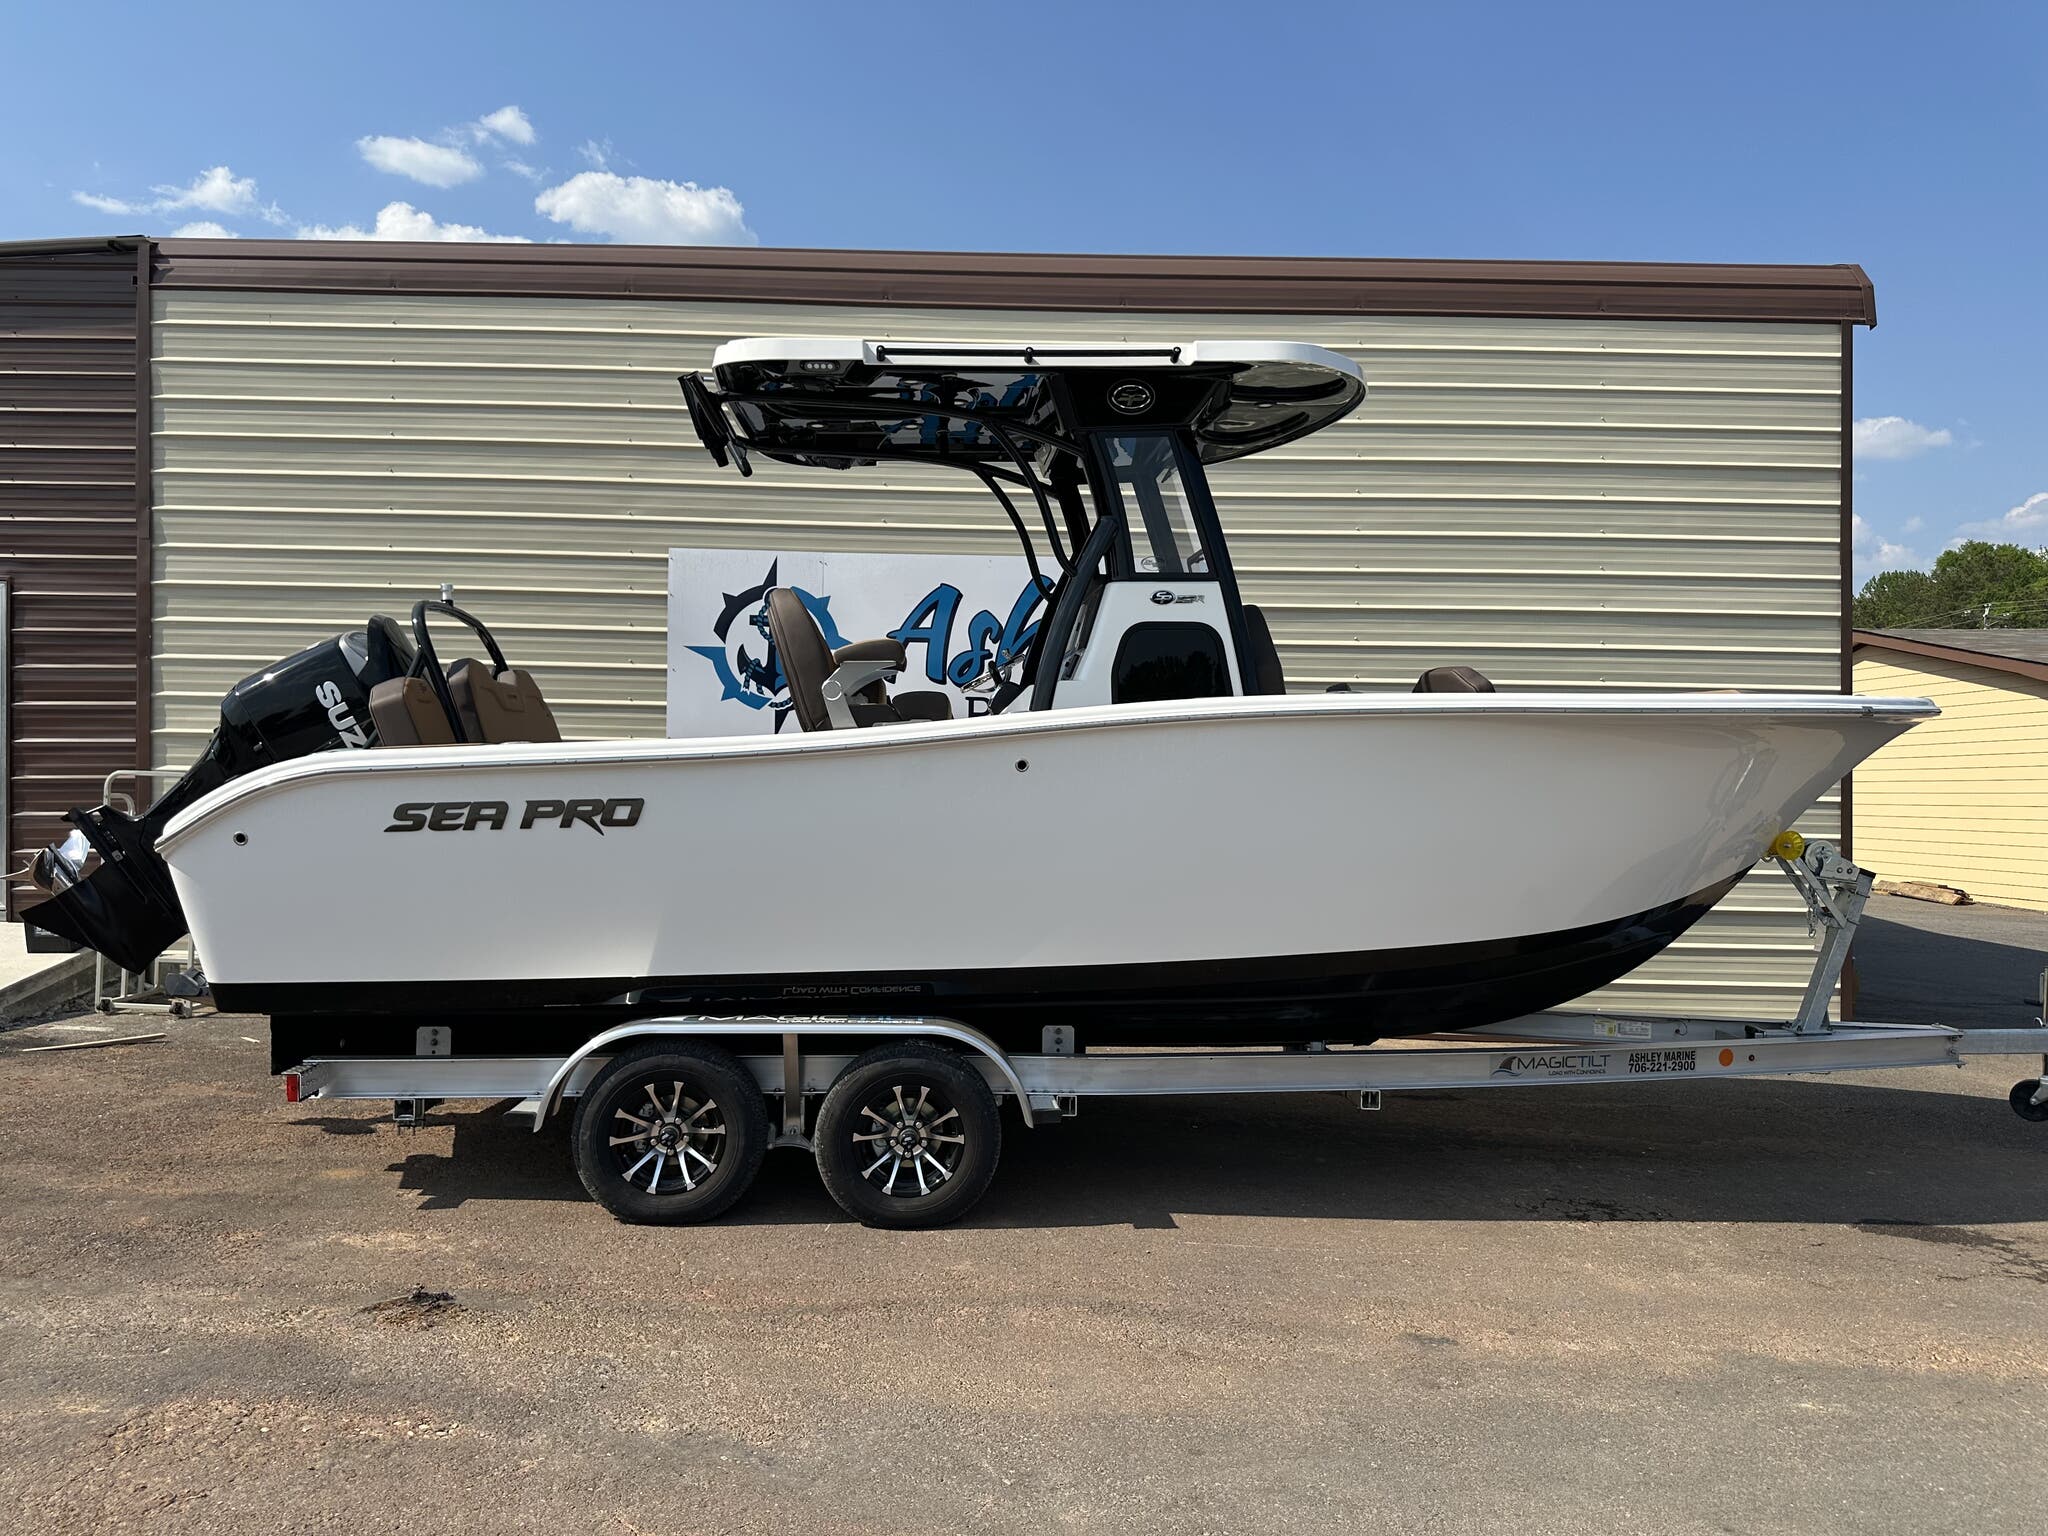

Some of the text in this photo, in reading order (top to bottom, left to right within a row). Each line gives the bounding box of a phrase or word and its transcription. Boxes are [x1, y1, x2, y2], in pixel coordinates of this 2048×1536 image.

[384, 798, 645, 836] SEA PRO
[1517, 1054, 1611, 1070] MAGICTILT
[1628, 1050, 1696, 1063] ASHLEY MARINE
[1628, 1060, 1696, 1073] 706-221-2900
